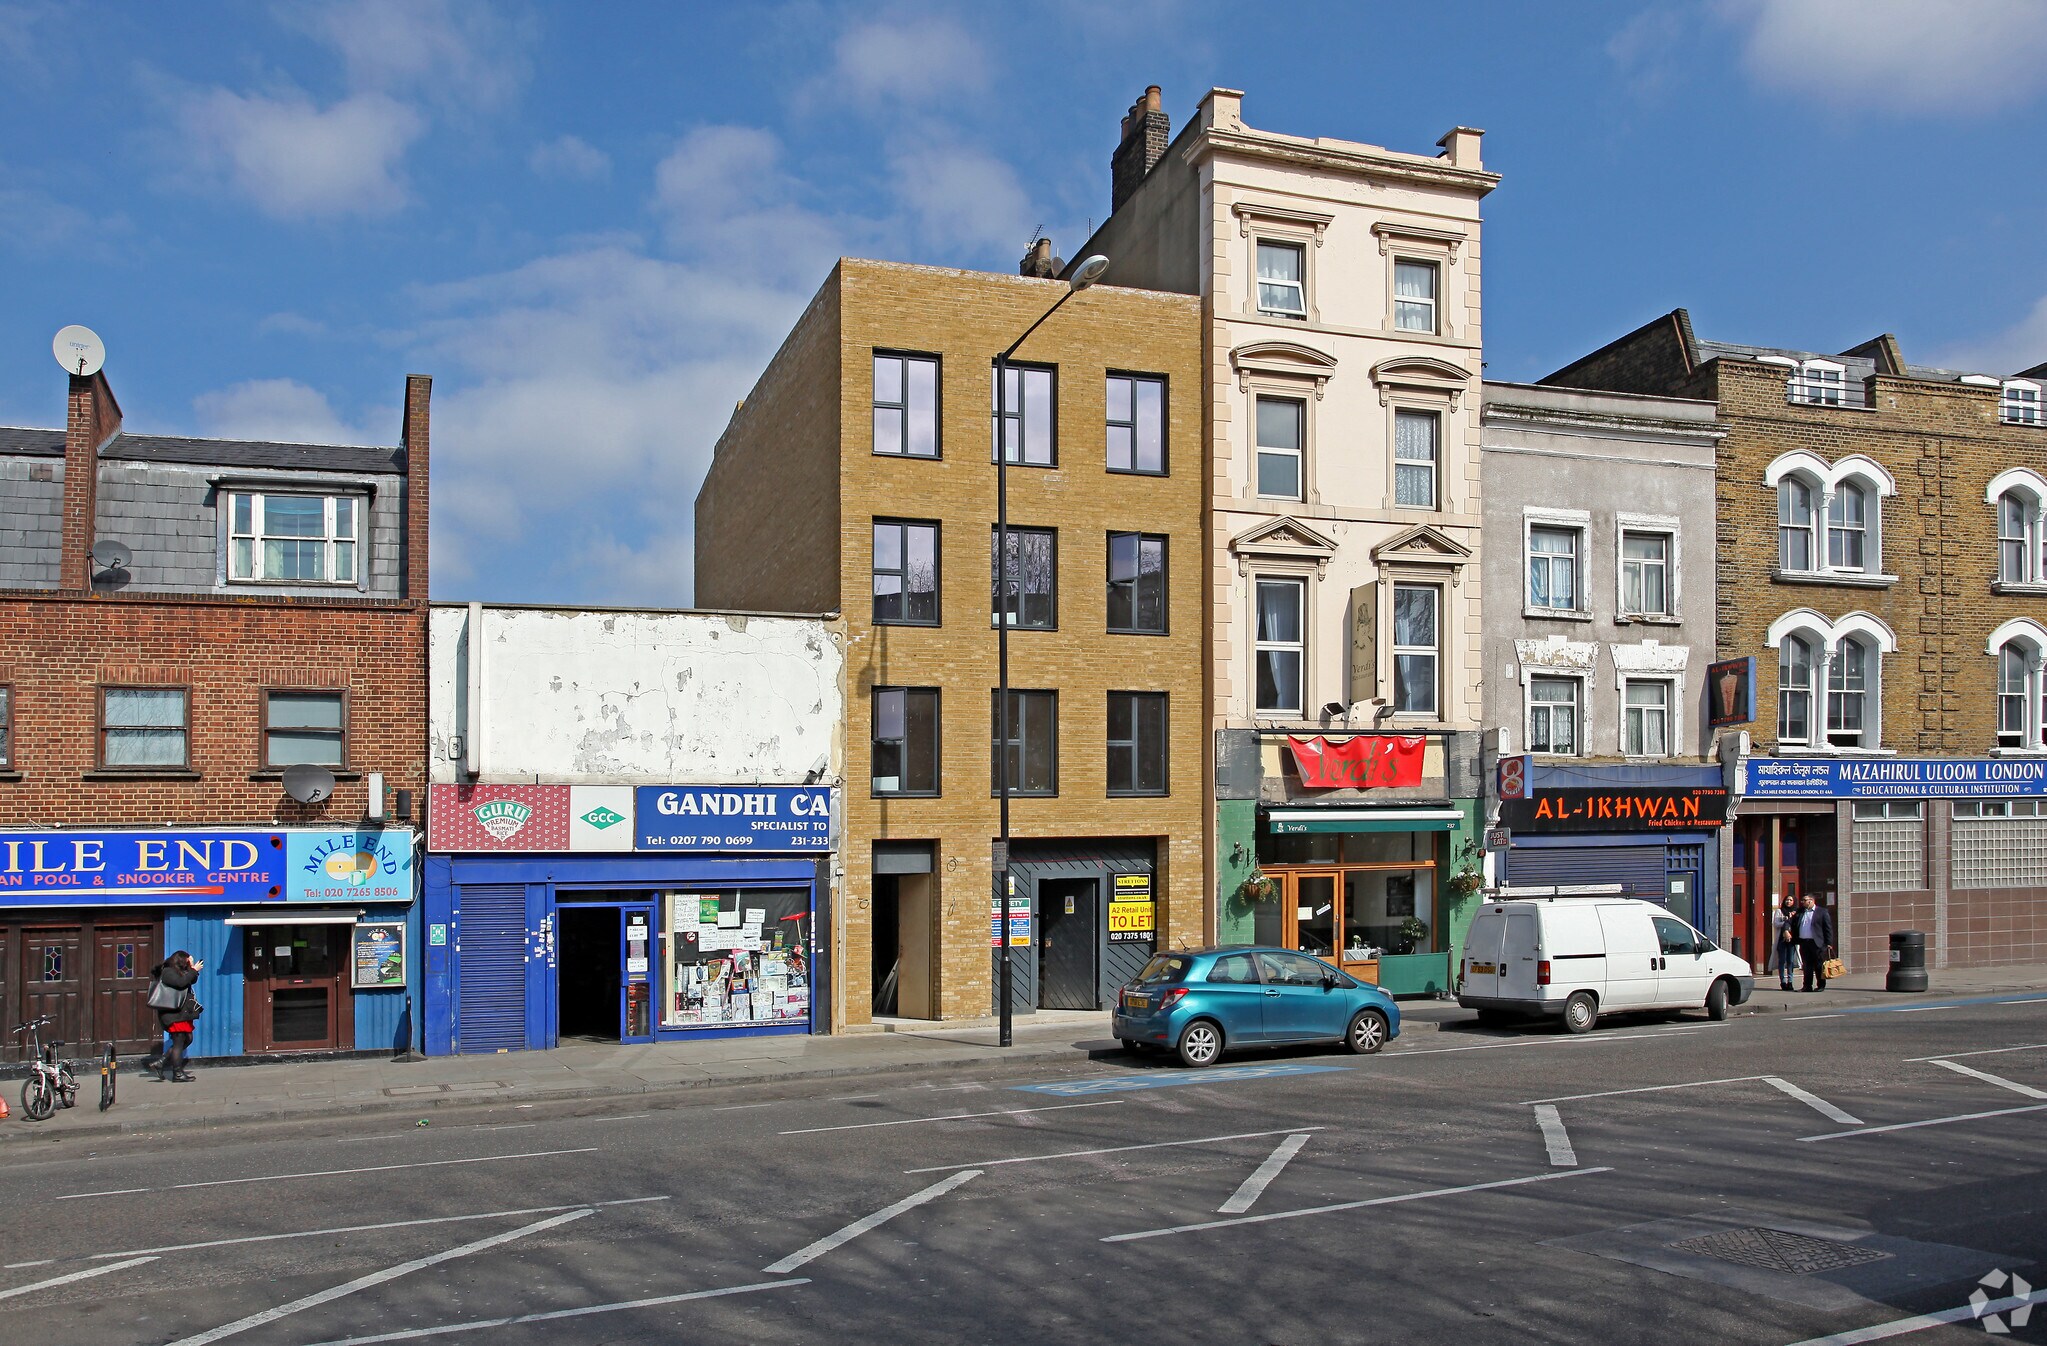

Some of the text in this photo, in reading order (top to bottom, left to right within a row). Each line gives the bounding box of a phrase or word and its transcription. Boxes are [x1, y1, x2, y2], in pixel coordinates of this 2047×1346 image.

[1315, 740, 1399, 782] Verdi's
[1839, 763, 2044, 780] MAZAHIRUL ULOOM LONDON
[1862, 784, 2020, 794] EDUCATIONAL & CULTURAL INSTITUTION
[656, 792, 830, 816] GANDHI CA
[1535, 796, 1700, 819] AL-IKHWAN
[478, 803, 527, 820] GURU
[486, 818, 518, 828] PREMIUM
[588, 812, 614, 823] GCC
[751, 822, 826, 830] SPECIALIST TO
[1288, 824, 1307, 832] Verdi's
[646, 836, 753, 845] Tel: 0207 790 0699
[791, 836, 828, 846] 231-233
[1490, 832, 1504, 840] JUST
[134, 840, 258, 870] END
[304, 834, 398, 876] MILE END
[34, 874, 81, 885] POOL
[92, 876, 104, 886] &
[117, 873, 195, 884] SNOOKER
[207, 872, 269, 883] CENTRE
[304, 887, 398, 898] Tel: 020 7265 8506
[1111, 915, 1152, 928] TO LET
[368, 928, 390, 937] MILE END
[1124, 932, 1138, 940] 7375
